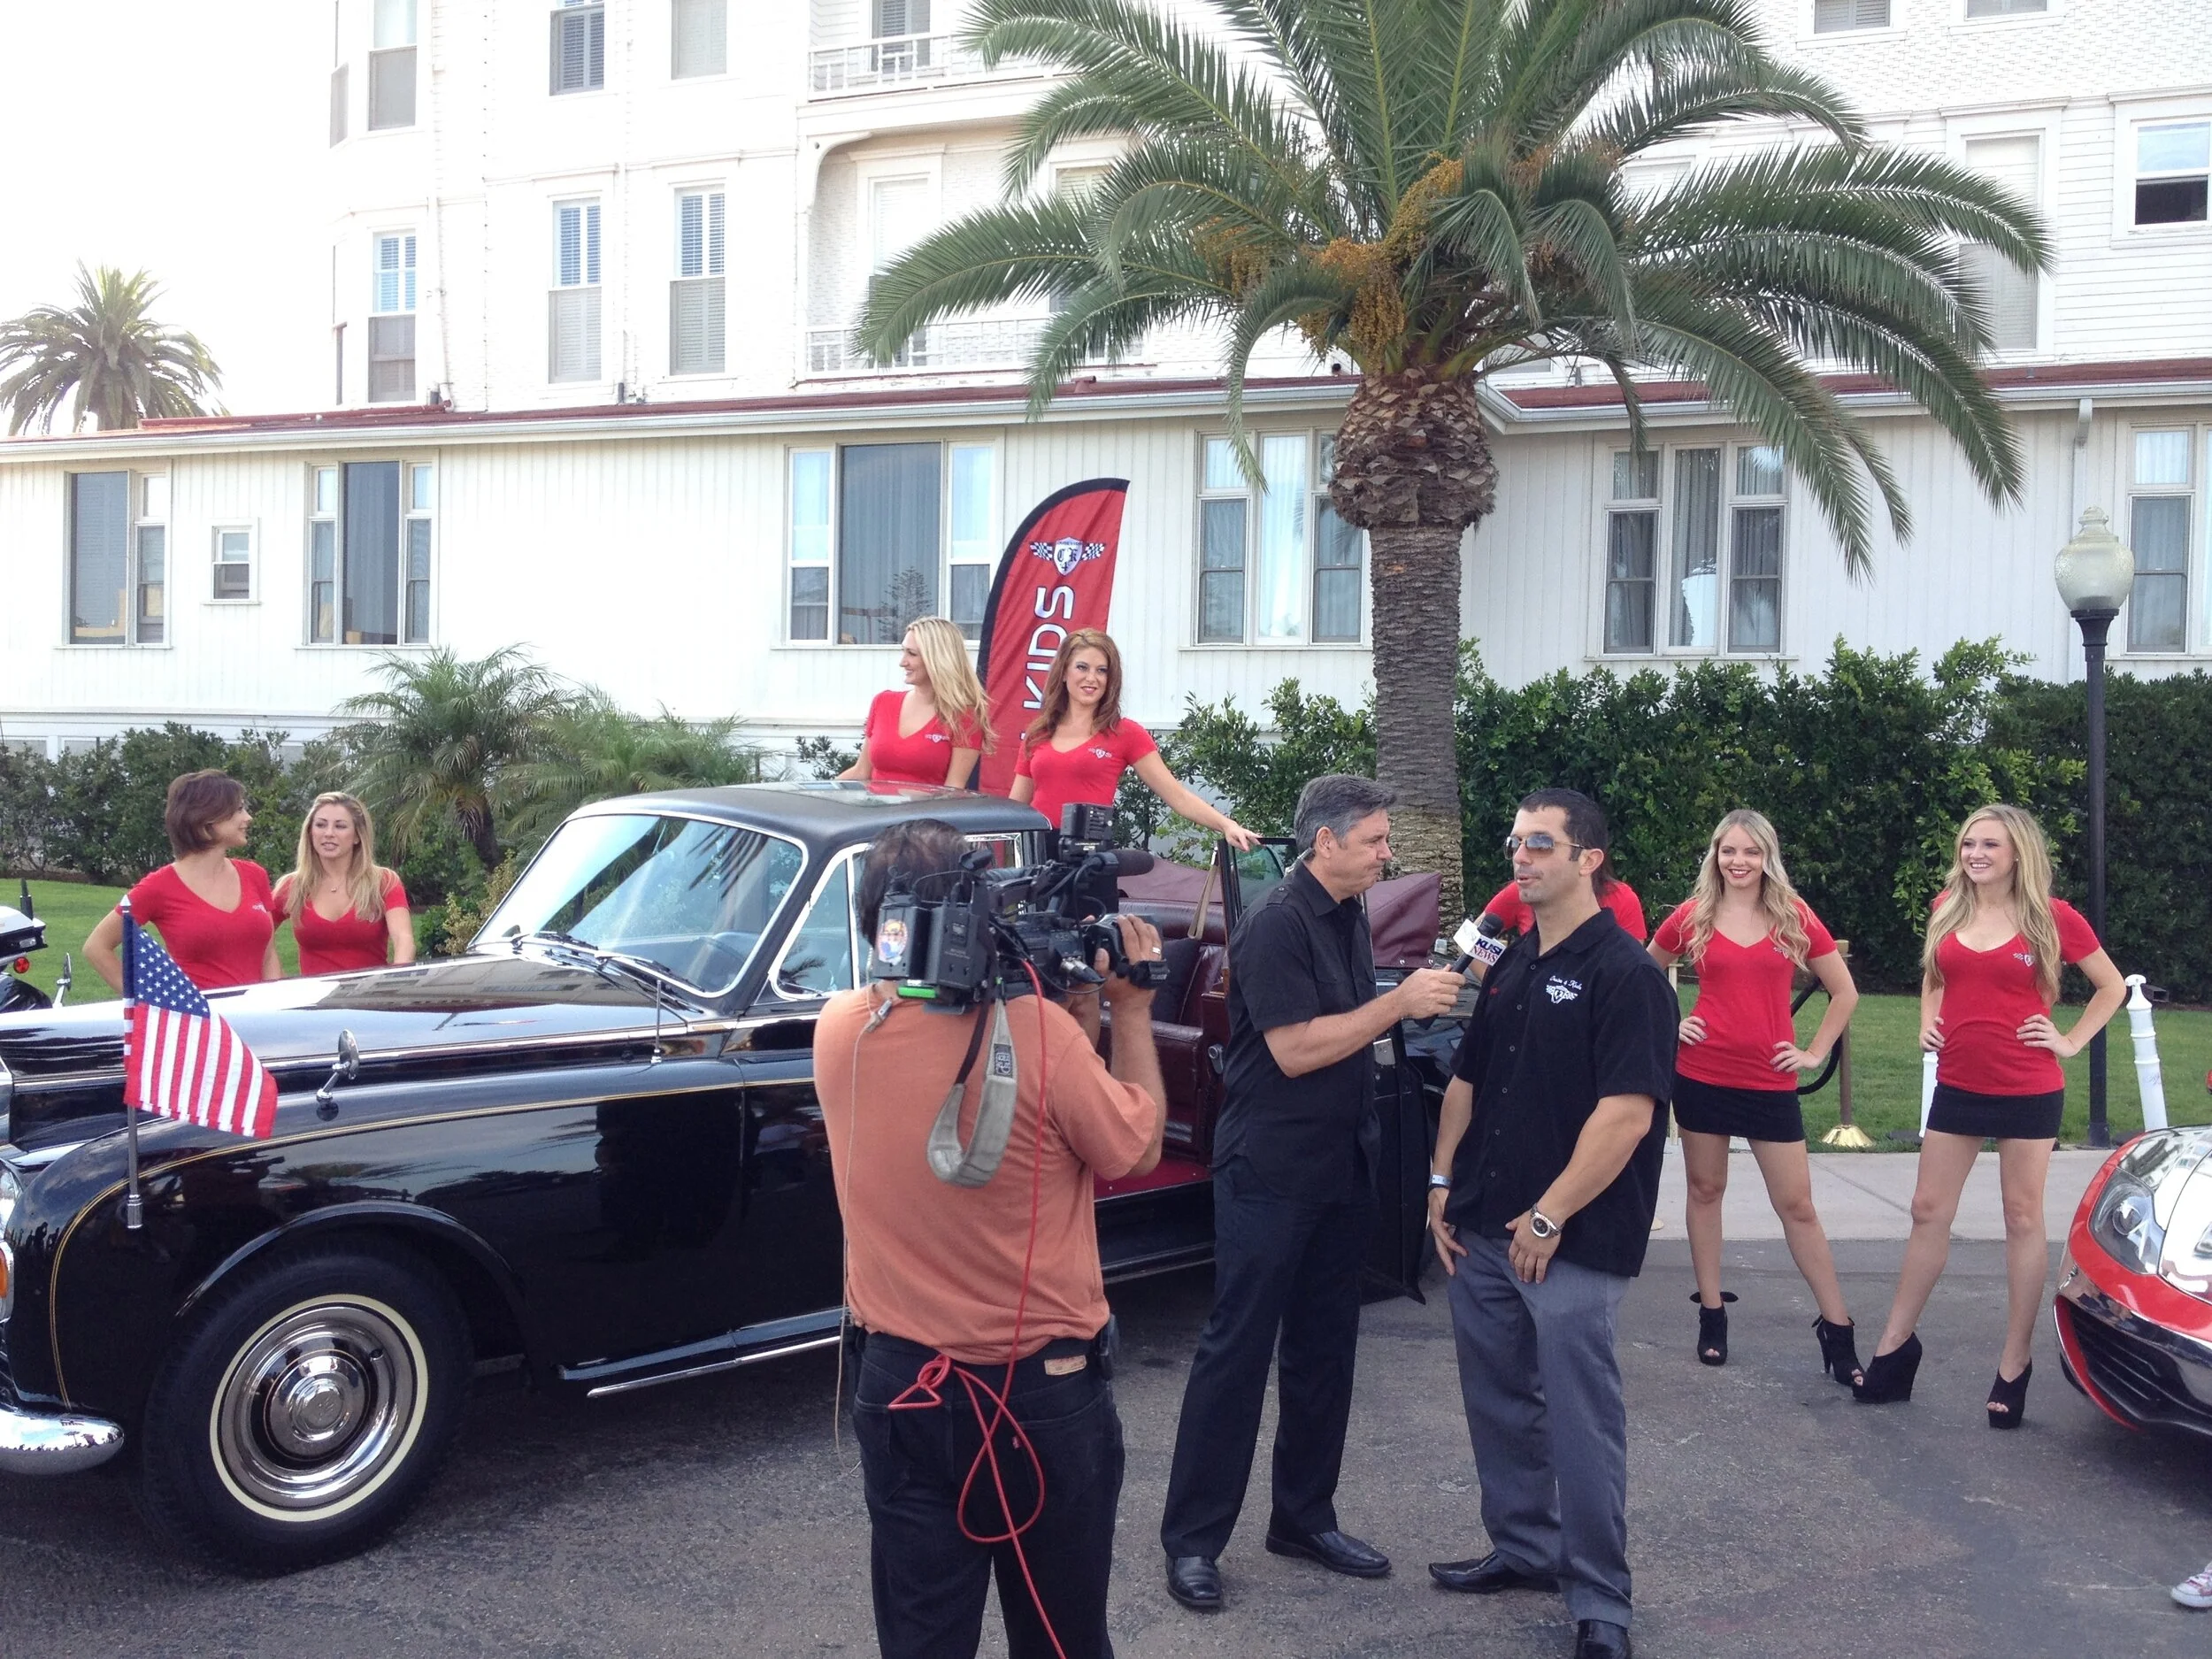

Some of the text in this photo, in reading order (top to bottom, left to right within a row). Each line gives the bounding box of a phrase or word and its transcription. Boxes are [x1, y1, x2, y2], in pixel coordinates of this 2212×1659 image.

[1023, 584, 1075, 710] KIDS
[1472, 946, 1498, 963] NEWS
[1475, 938, 1502, 956] KUSI
